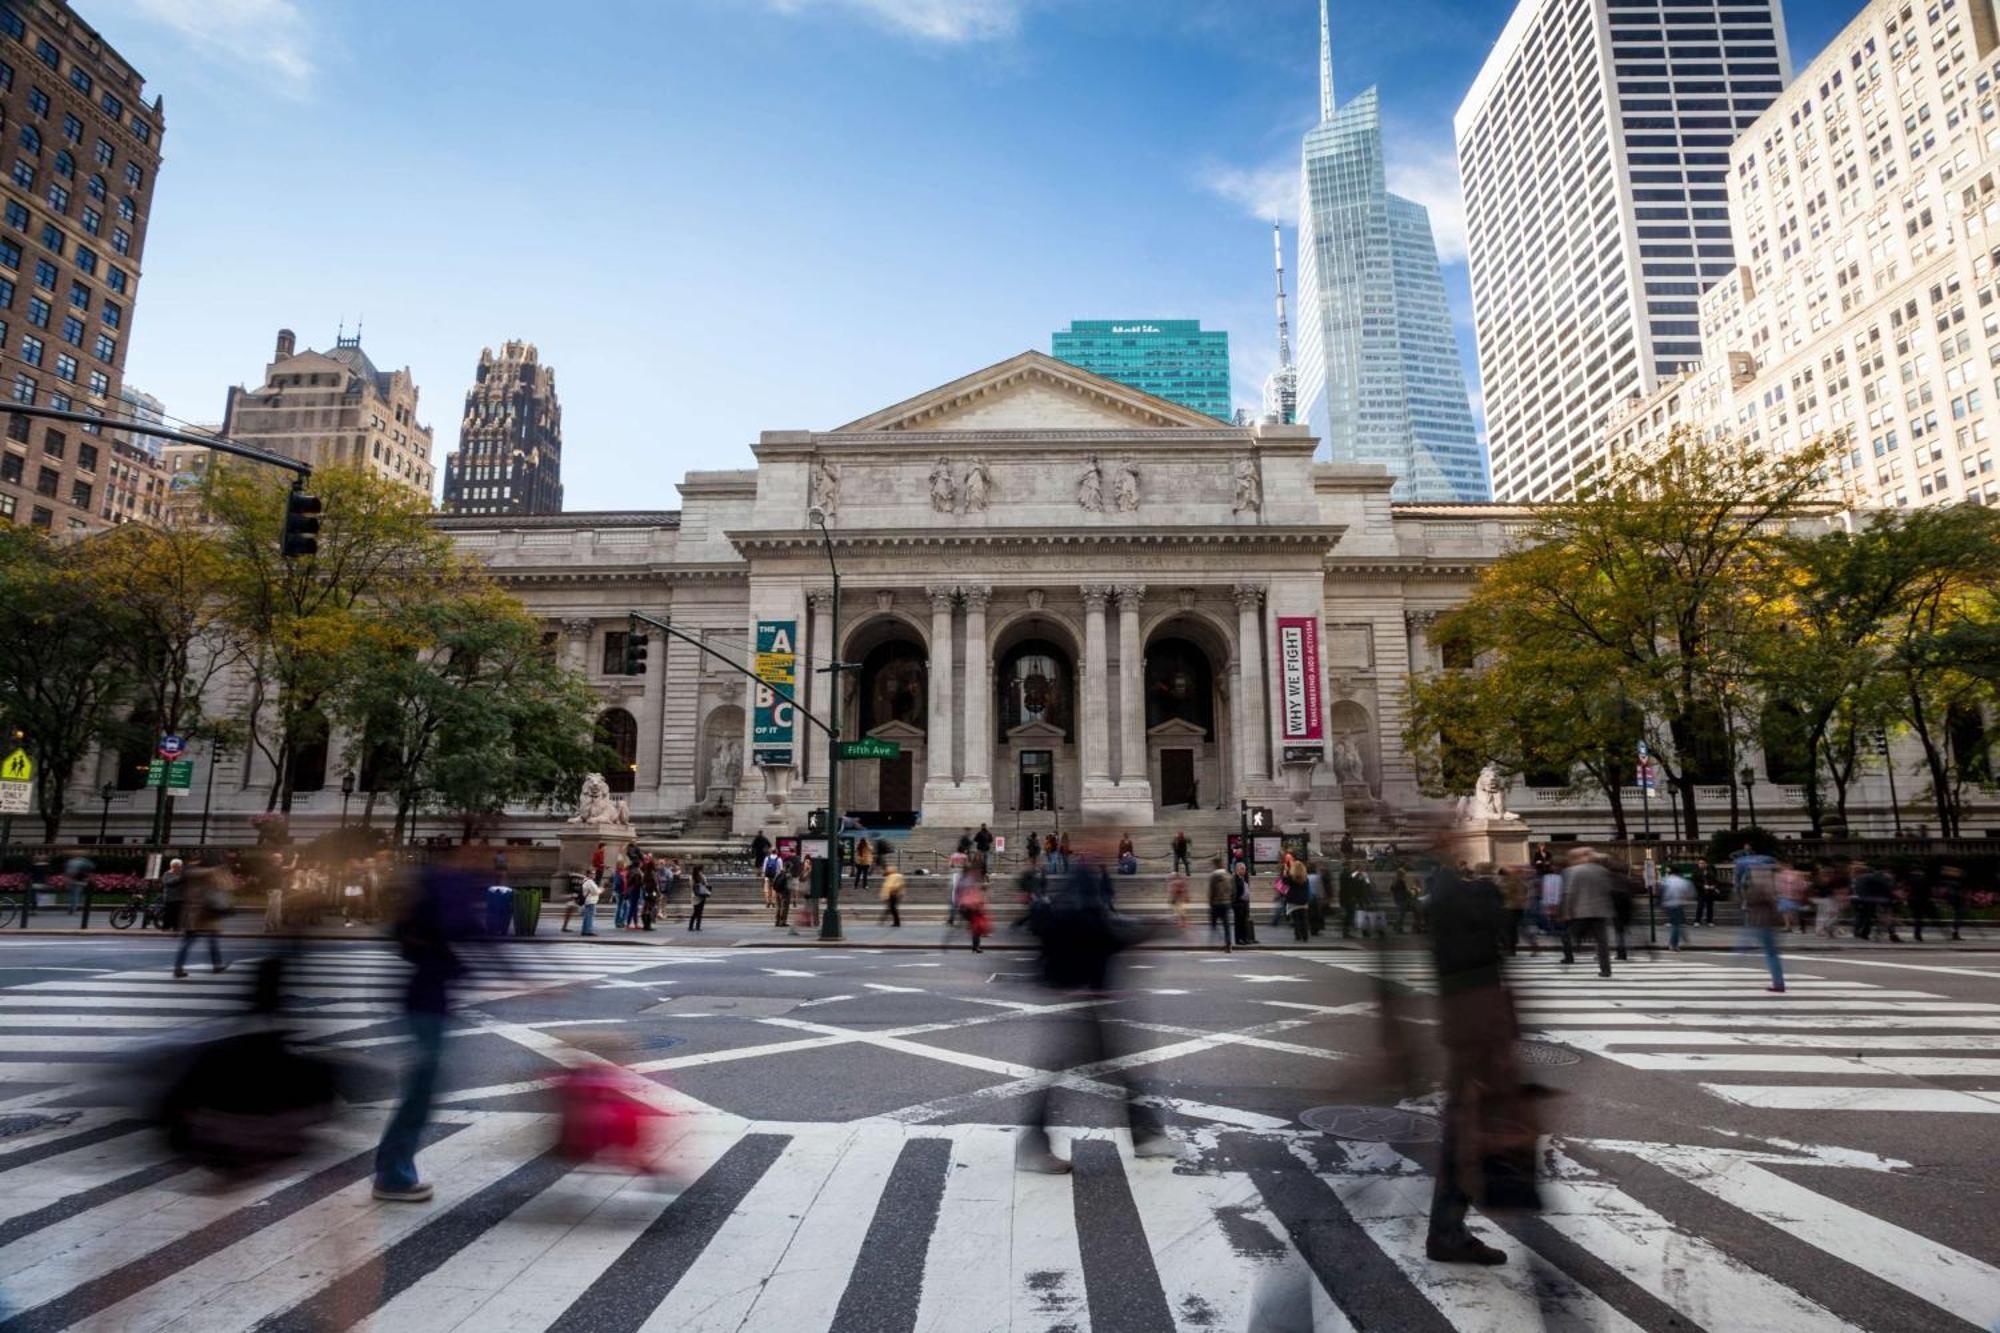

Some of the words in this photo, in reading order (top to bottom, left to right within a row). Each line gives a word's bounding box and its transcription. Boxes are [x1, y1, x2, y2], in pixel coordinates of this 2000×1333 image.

[941, 558, 978, 569] NEW
[991, 558, 1031, 569] YORK
[759, 625, 776, 633] THE
[771, 629, 792, 653] A
[1286, 630, 1299, 671] FIGHT
[755, 683, 774, 708] B
[1289, 676, 1300, 696] WE
[774, 702, 792, 727] C
[1290, 700, 1302, 731] WHY
[848, 745, 870, 754] Fifth
[873, 746, 890, 755] Ave
